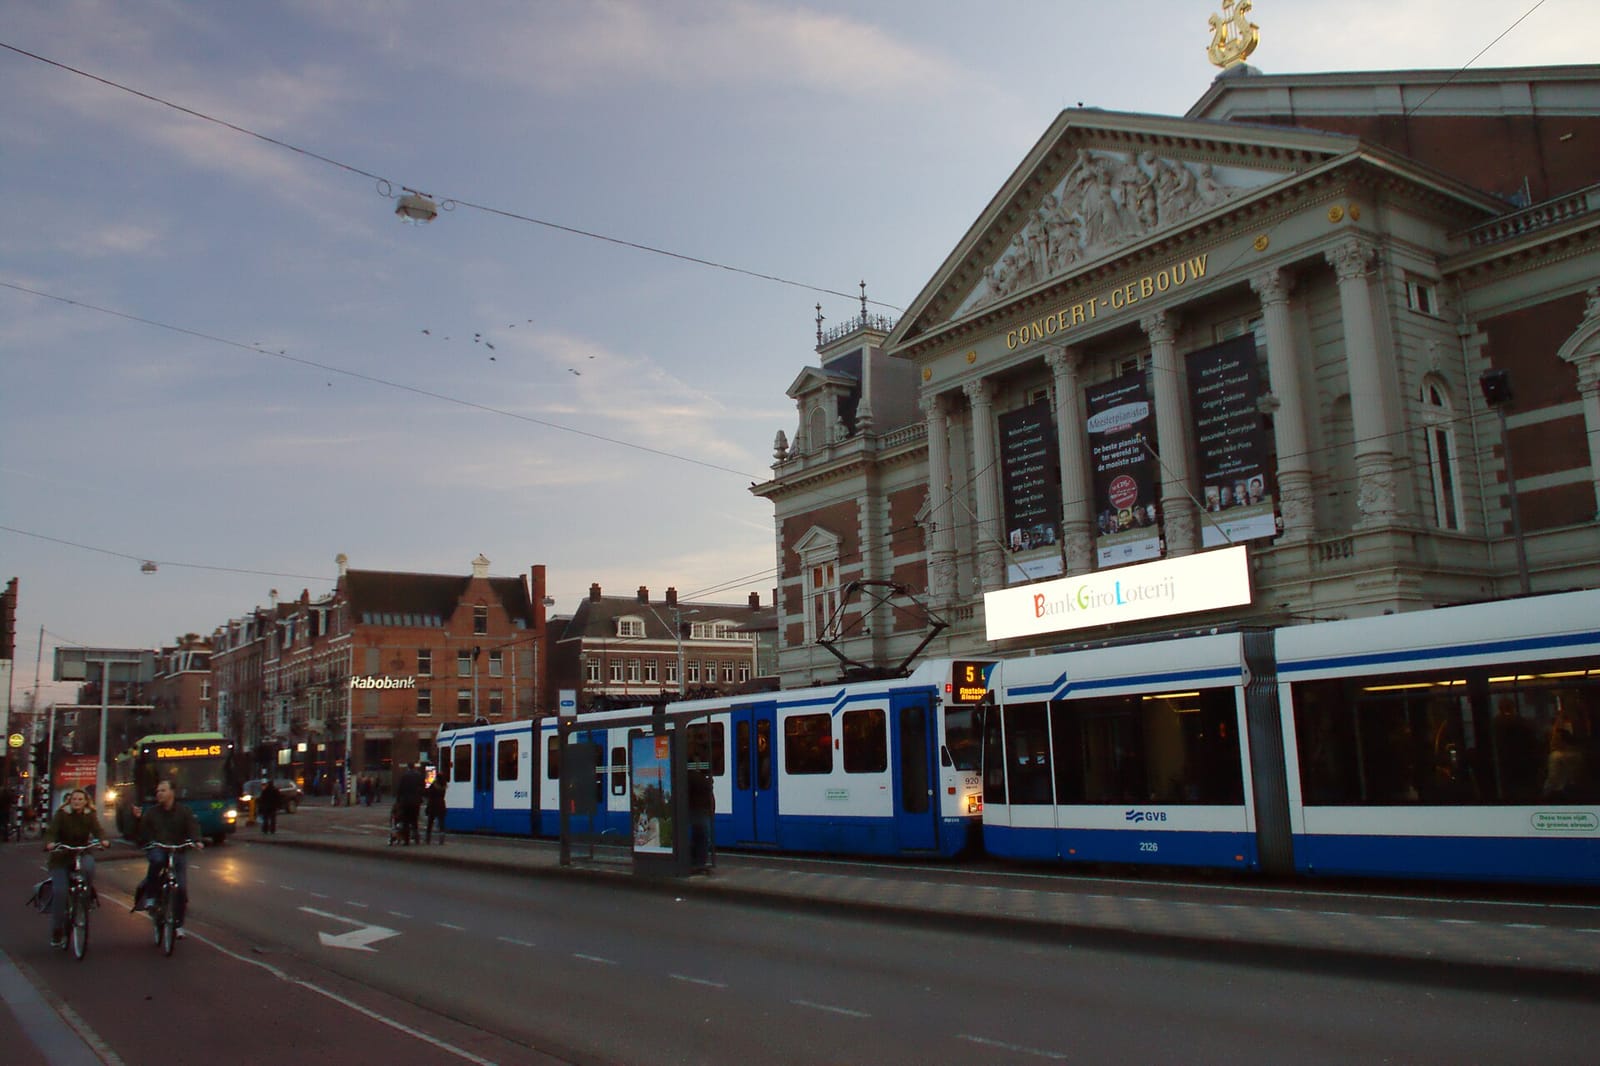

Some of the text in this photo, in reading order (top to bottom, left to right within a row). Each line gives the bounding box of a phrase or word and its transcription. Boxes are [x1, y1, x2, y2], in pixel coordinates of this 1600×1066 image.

[1094, 435, 1147, 454] De beste pianistn
[1102, 446, 1140, 461] ter wereld in
[1098, 463, 1105, 471] de
[1106, 458, 1129, 469] mooiste
[1034, 576, 1176, 618] BankGiroLoterij
[966, 666, 974, 682] 5
[350, 675, 416, 689] Rabobank
[965, 777, 979, 785] 920
[1145, 811, 1167, 822] GVB
[1139, 842, 1159, 852] 2126
